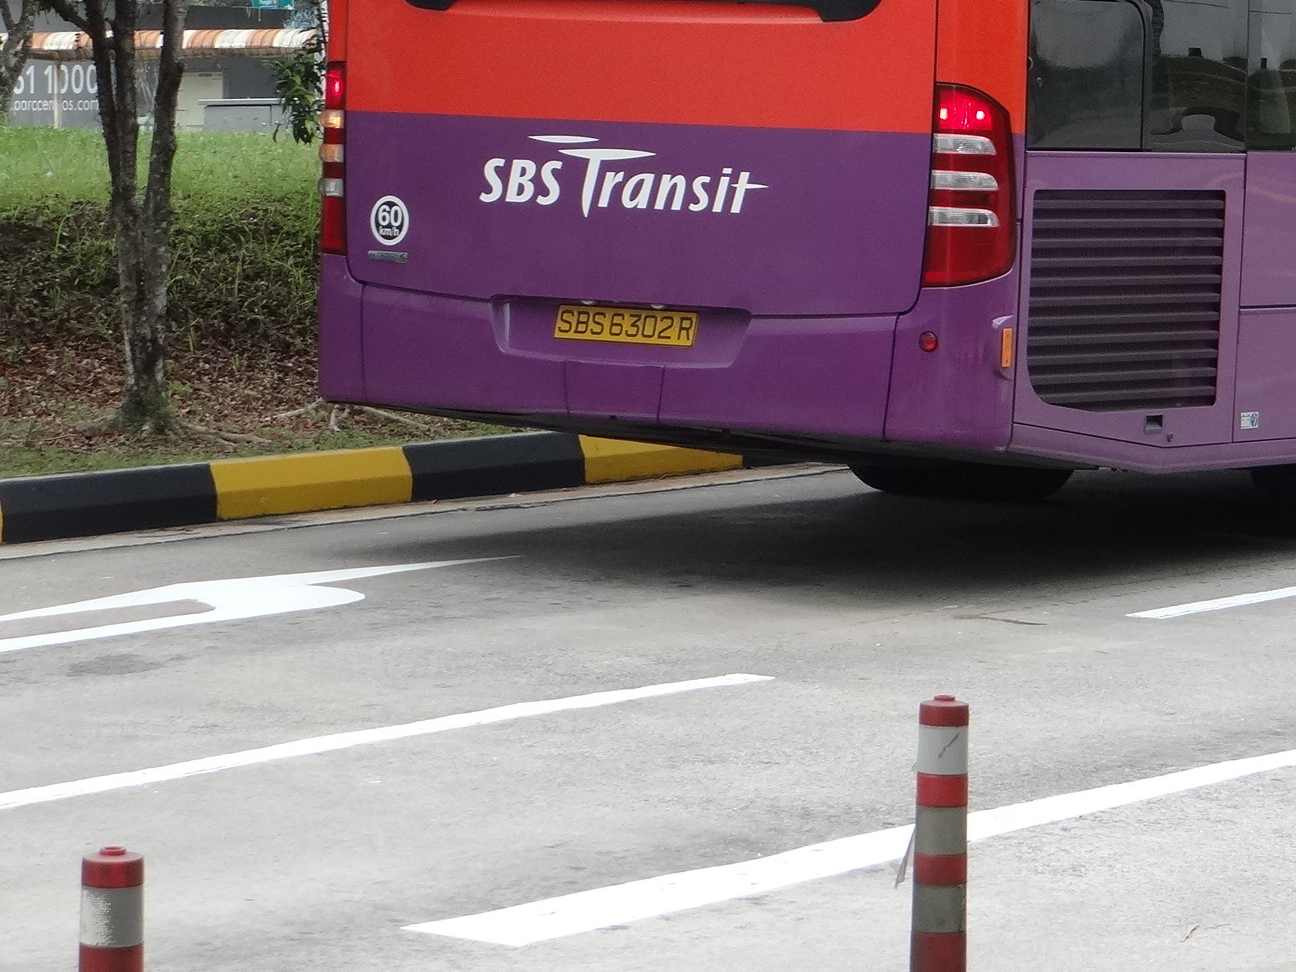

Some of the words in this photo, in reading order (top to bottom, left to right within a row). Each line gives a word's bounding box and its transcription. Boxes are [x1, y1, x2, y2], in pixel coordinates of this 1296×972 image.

[14, 100, 99, 112] parccenos.com
[480, 158, 563, 205] SBS
[558, 148, 770, 217] Transit
[378, 204, 402, 226] 60
[379, 226, 400, 236] km/h
[558, 310, 692, 341] SBS6302R
